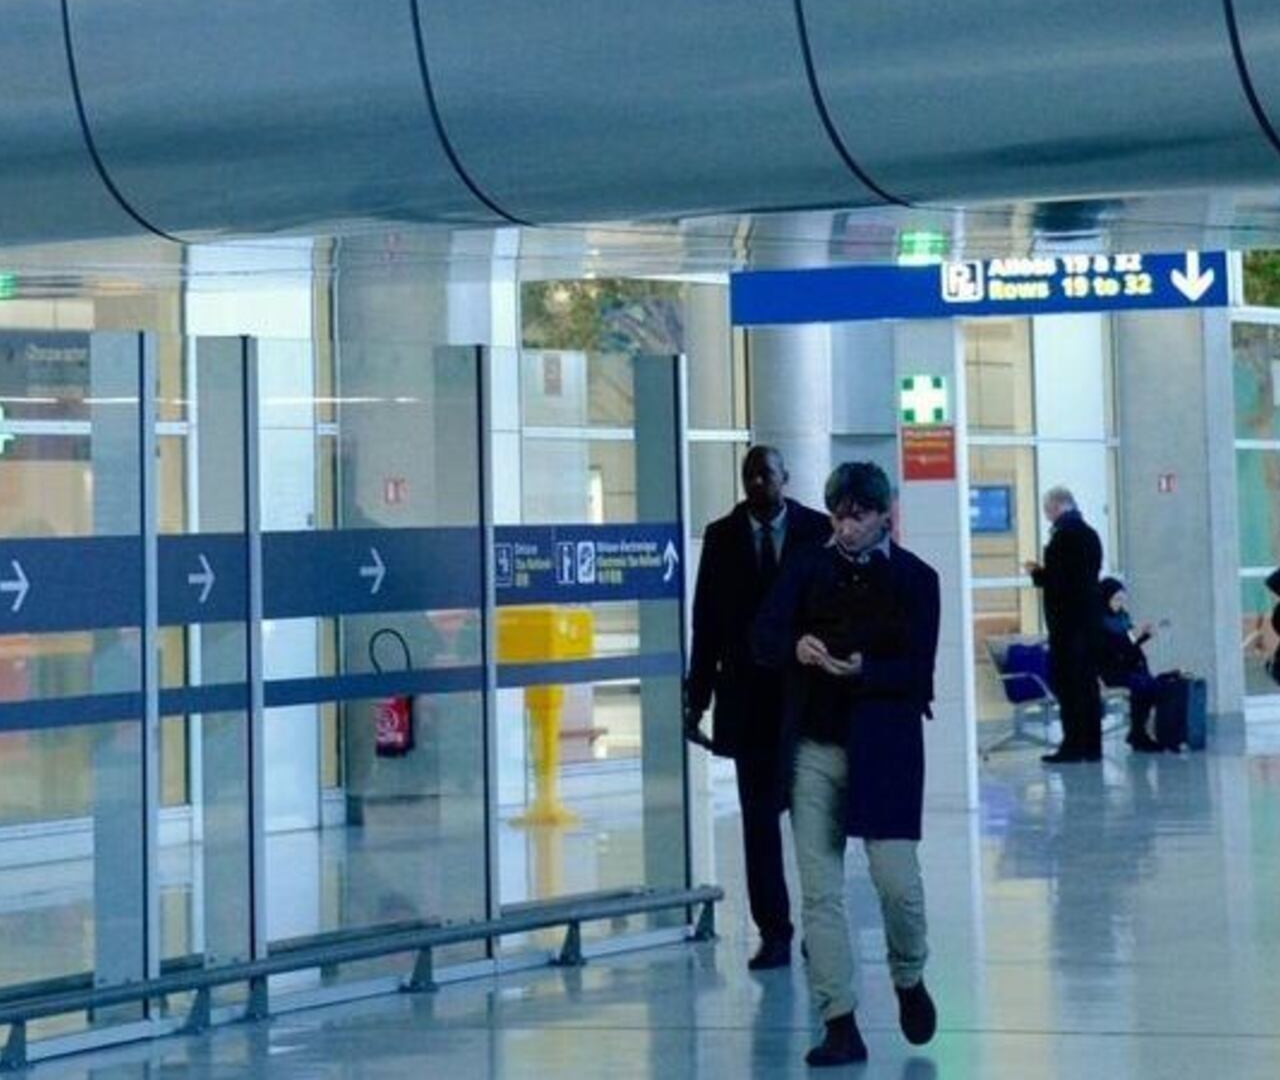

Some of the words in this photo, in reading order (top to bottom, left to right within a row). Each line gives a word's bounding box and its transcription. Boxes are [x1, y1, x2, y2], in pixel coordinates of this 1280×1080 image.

[989, 278, 1050, 300] Rows
[1062, 275, 1090, 298] 19
[1093, 275, 1120, 296] to
[1123, 273, 1153, 295] 32
